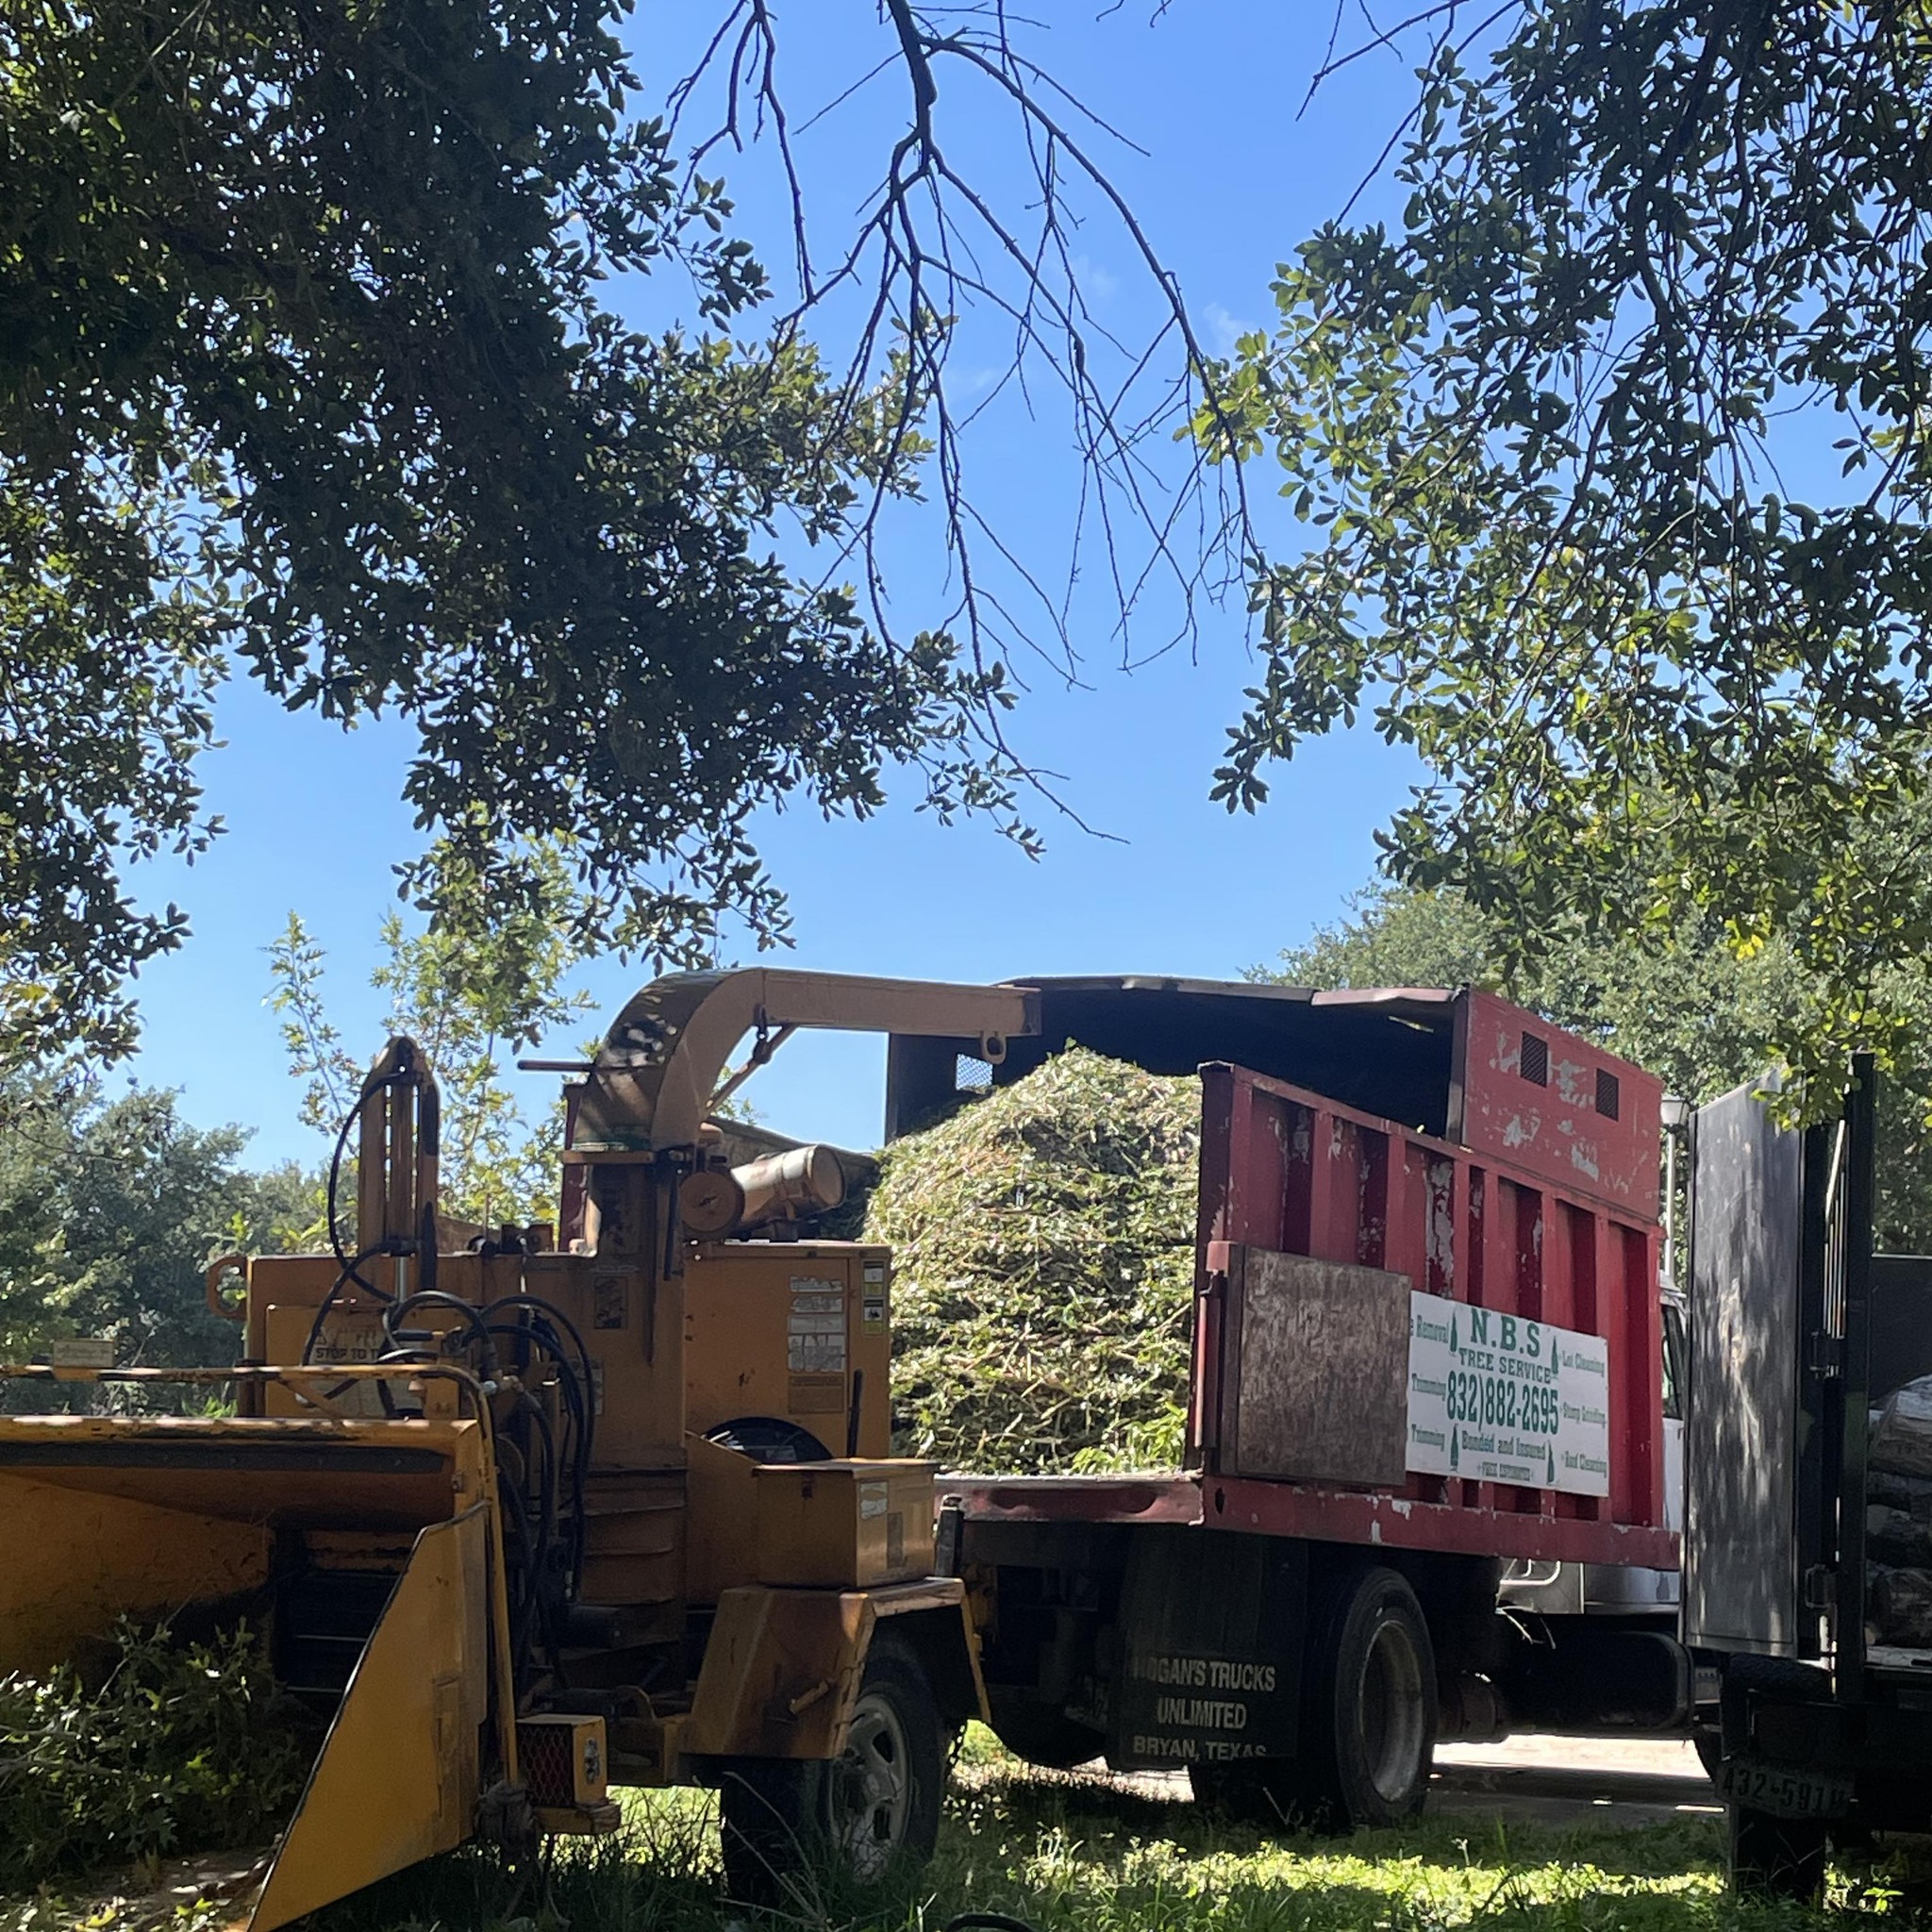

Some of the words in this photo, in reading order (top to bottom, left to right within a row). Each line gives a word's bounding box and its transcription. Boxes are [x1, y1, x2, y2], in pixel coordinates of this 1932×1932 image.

[1416, 1315, 1449, 1344] Removal
[1471, 1307, 1541, 1358] N.B.S
[1458, 1347, 1494, 1371] TREE
[1499, 1357, 1552, 1385] SERVICE
[1447, 1371, 1558, 1435] 832)882-2695
[1498, 1438, 1513, 1456] and
[1209, 1660, 1275, 1691] TRUCKS
[1157, 1697, 1247, 1729] UNLIMITED
[1132, 1736, 1201, 1762] BRYAN,
[1205, 1740, 1267, 1761] TEXAS
